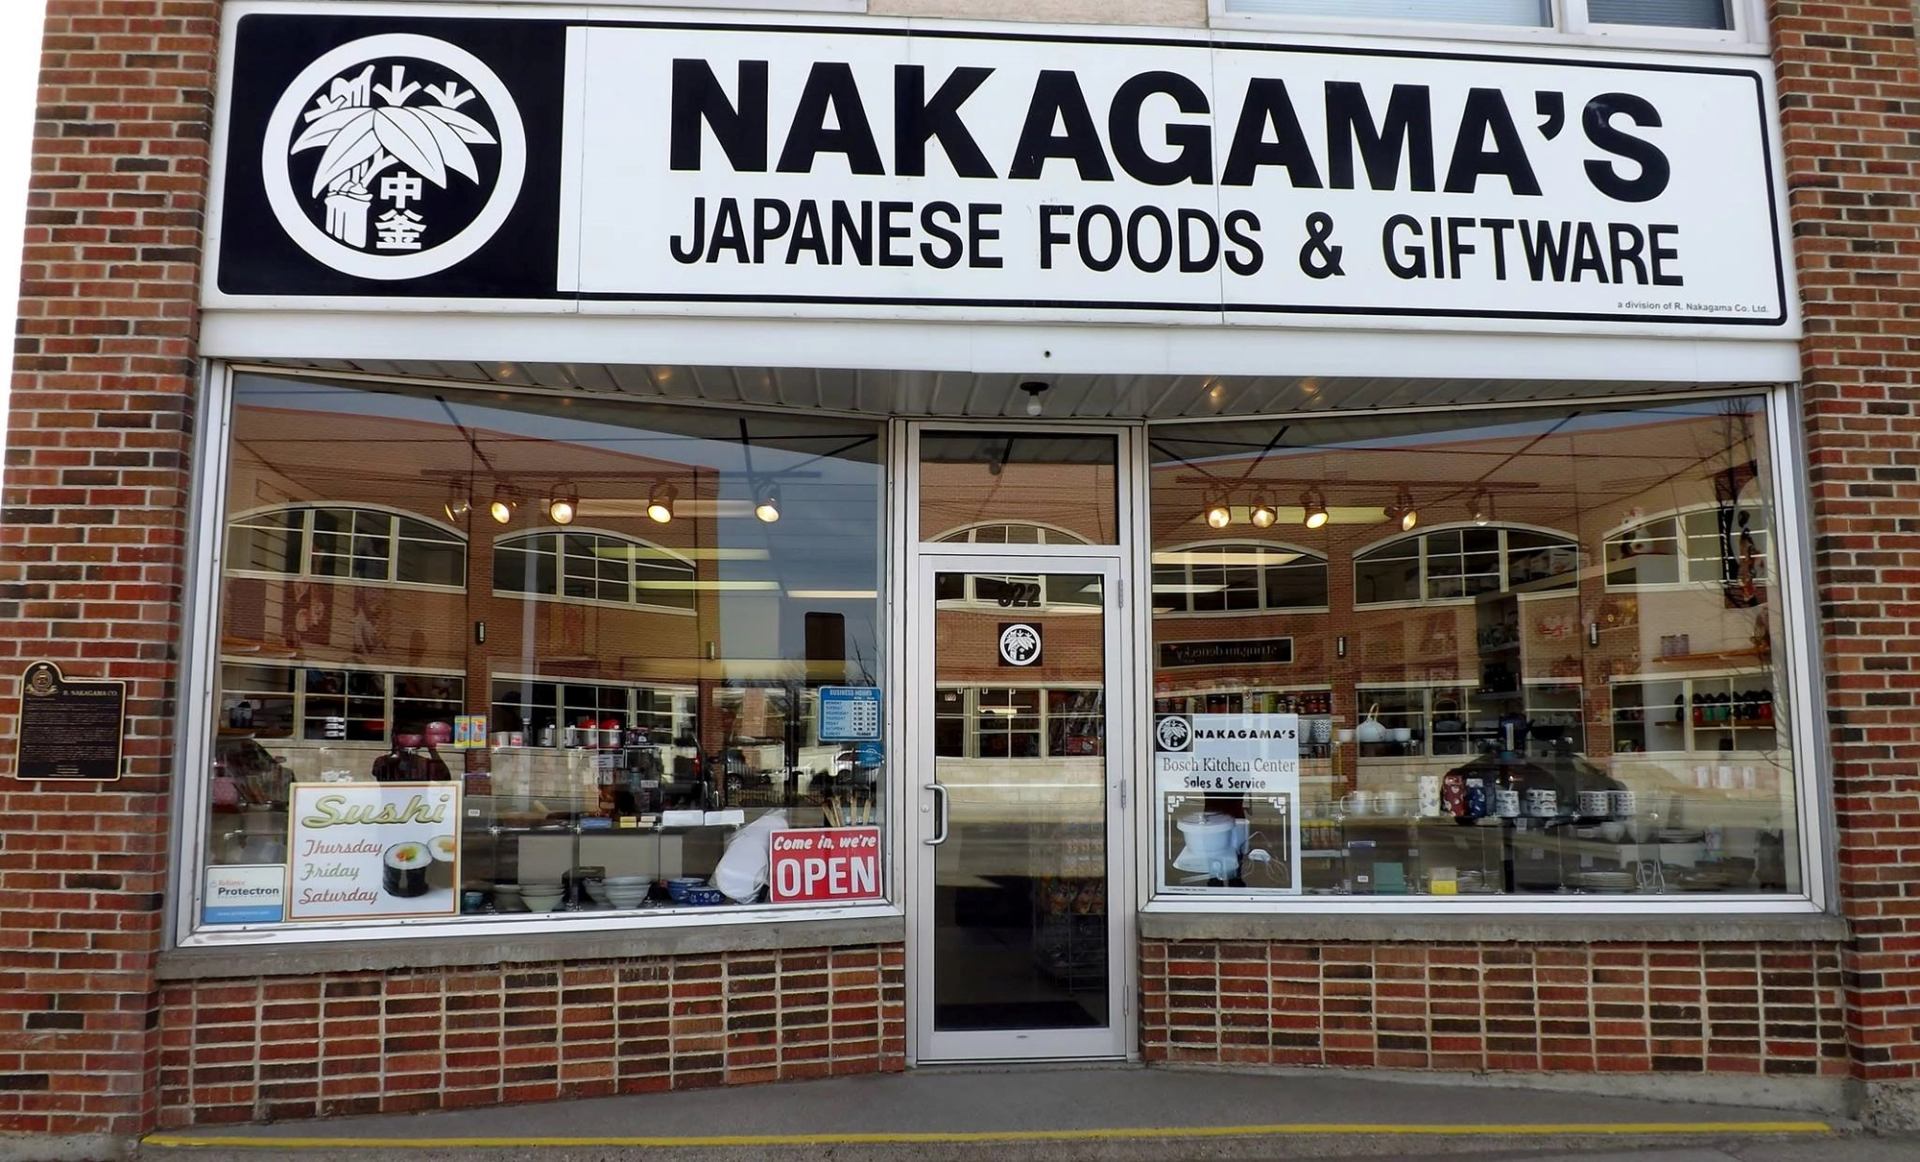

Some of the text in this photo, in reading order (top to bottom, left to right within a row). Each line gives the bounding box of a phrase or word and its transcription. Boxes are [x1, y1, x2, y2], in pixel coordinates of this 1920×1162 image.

[670, 58, 1670, 202] NAKAGAMA'S
[669, 196, 1684, 287] JAPANESE FOODS & GIFTWARE
[1625, 301, 1660, 310] division
[1663, 302, 1672, 310] of
[1686, 303, 1732, 313] Nakagama
[1735, 304, 1750, 312] Co.
[1752, 305, 1768, 313] Ltd.
[1194, 729, 1296, 739] NAKAGAMA'S
[1163, 757, 1296, 773] Bosch Kitchen Center
[1184, 776, 1266, 789] Sales & Service
[301, 793, 450, 829] Sushi
[302, 838, 383, 857] Thursday
[773, 834, 877, 852] Come in, we're
[300, 862, 360, 882] Friday
[777, 857, 875, 897] OPEN
[218, 887, 279, 895] Protectron
[298, 886, 378, 905] Saturday
